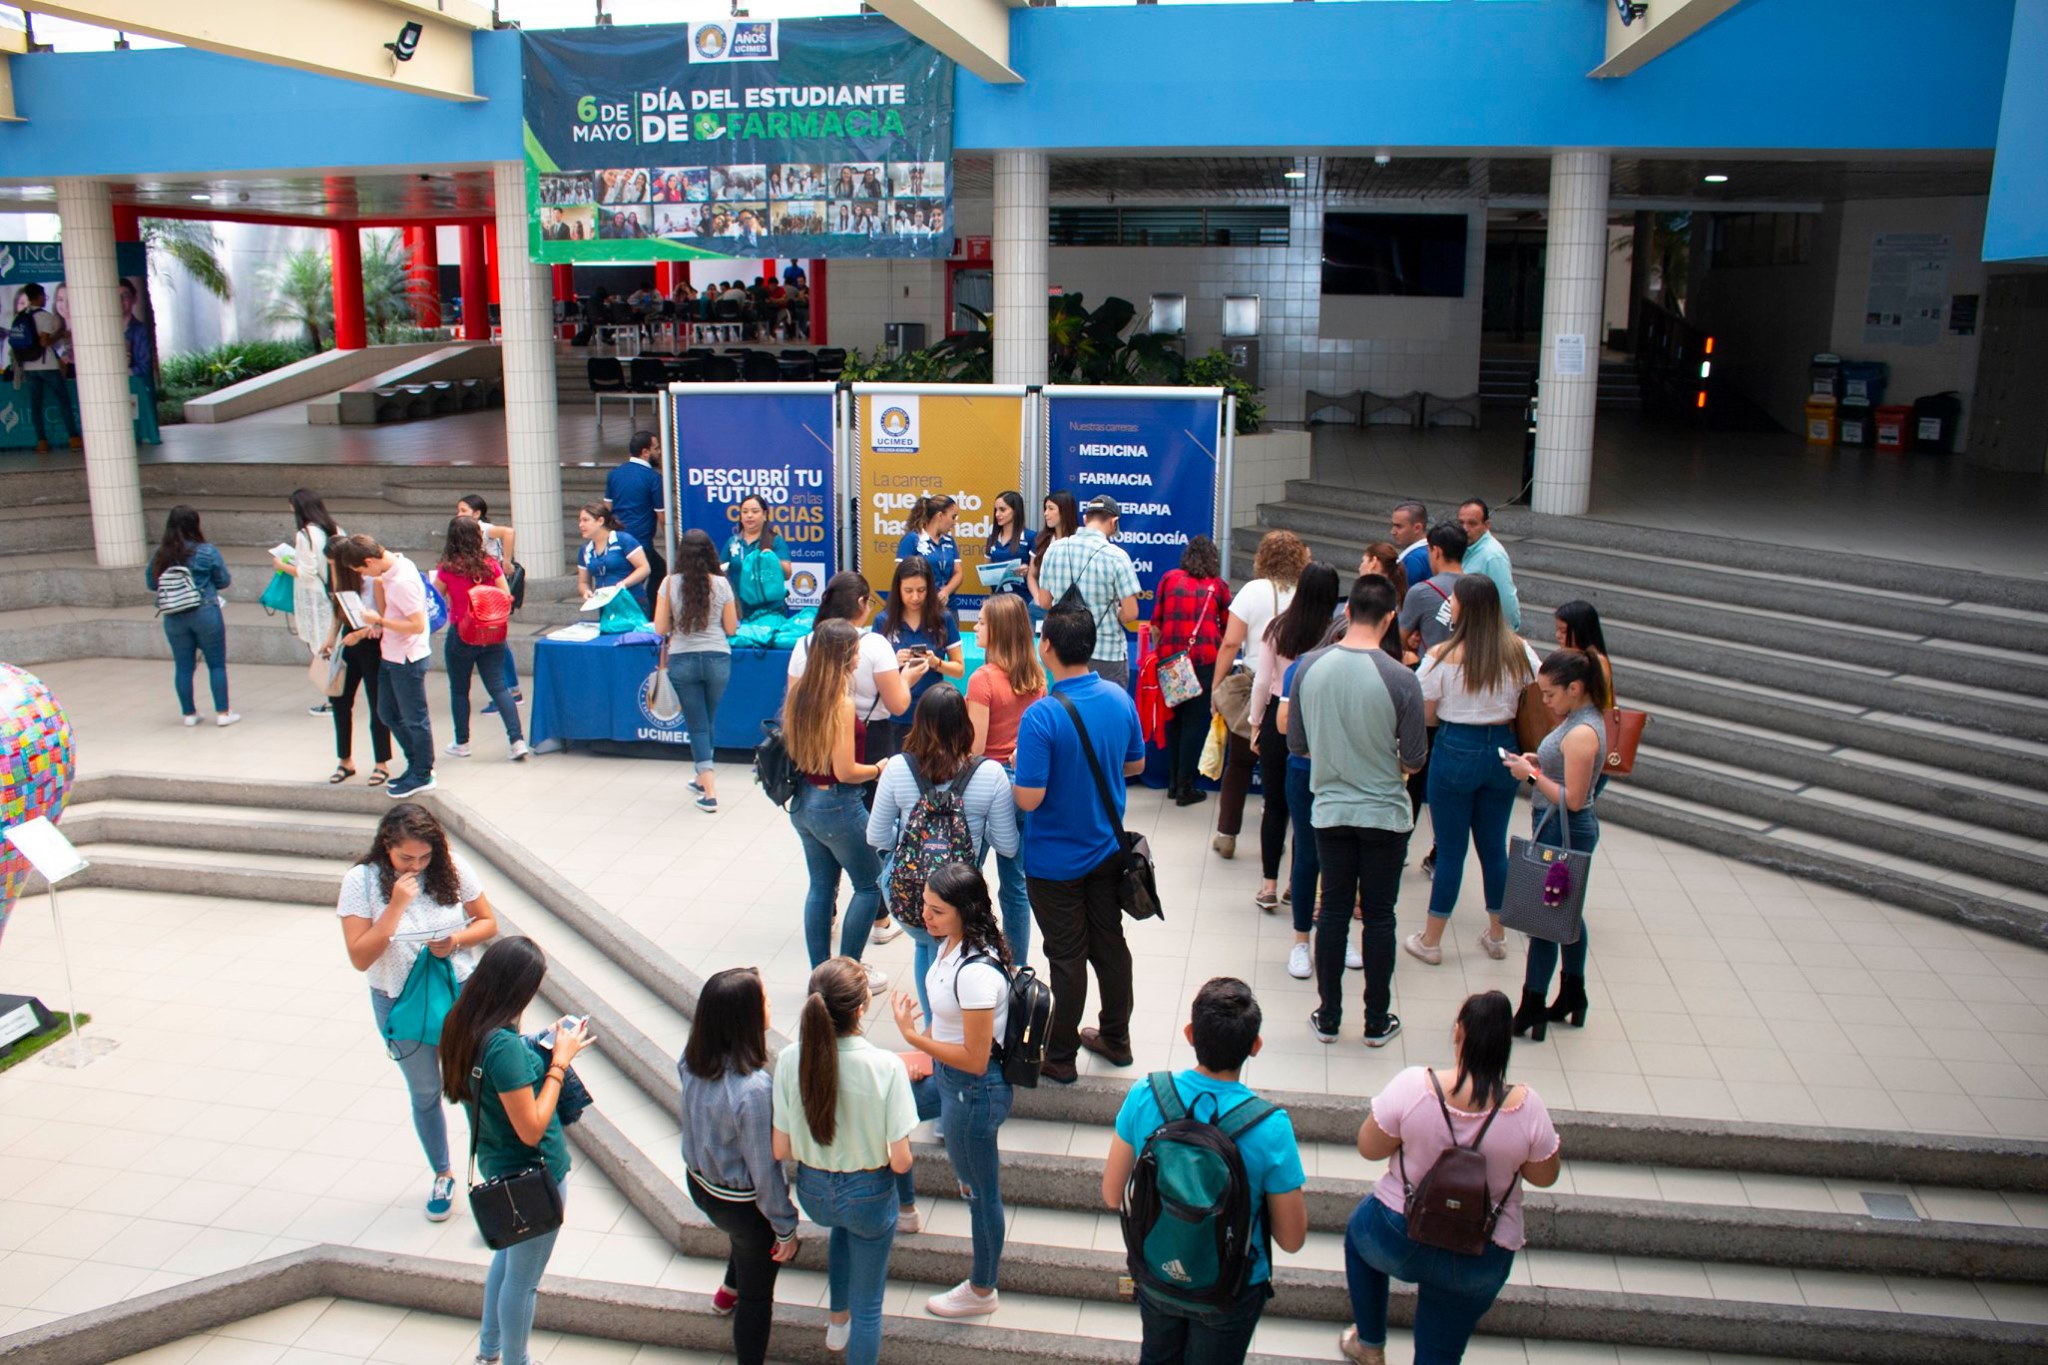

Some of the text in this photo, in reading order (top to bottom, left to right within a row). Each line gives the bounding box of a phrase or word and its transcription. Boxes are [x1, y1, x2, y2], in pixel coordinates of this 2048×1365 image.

[735, 31, 767, 44] AÑOS
[734, 45, 767, 53] UCIMED
[642, 84, 906, 112] DÍA DEL ESTUDIANTE
[577, 95, 629, 123] 6 DE
[573, 123, 632, 142] MAYO
[641, 109, 905, 143] DE FARMACIA
[1069, 422, 1105, 431] Nuestras
[877, 438, 913, 446] UCIMED
[1079, 444, 1149, 458] MEDICINA
[688, 464, 823, 487] DESCUBRÍ TU
[873, 471, 942, 488] La carrera
[1079, 472, 1153, 486] FARMACIA
[792, 494, 807, 505] en
[807, 491, 823, 505] las
[873, 492, 917, 514] que
[726, 505, 824, 524] CCIAS
[772, 525, 825, 542] ALUD
[1110, 531, 1189, 545] OBIOLOGÍA
[790, 547, 825, 557] ed.com
